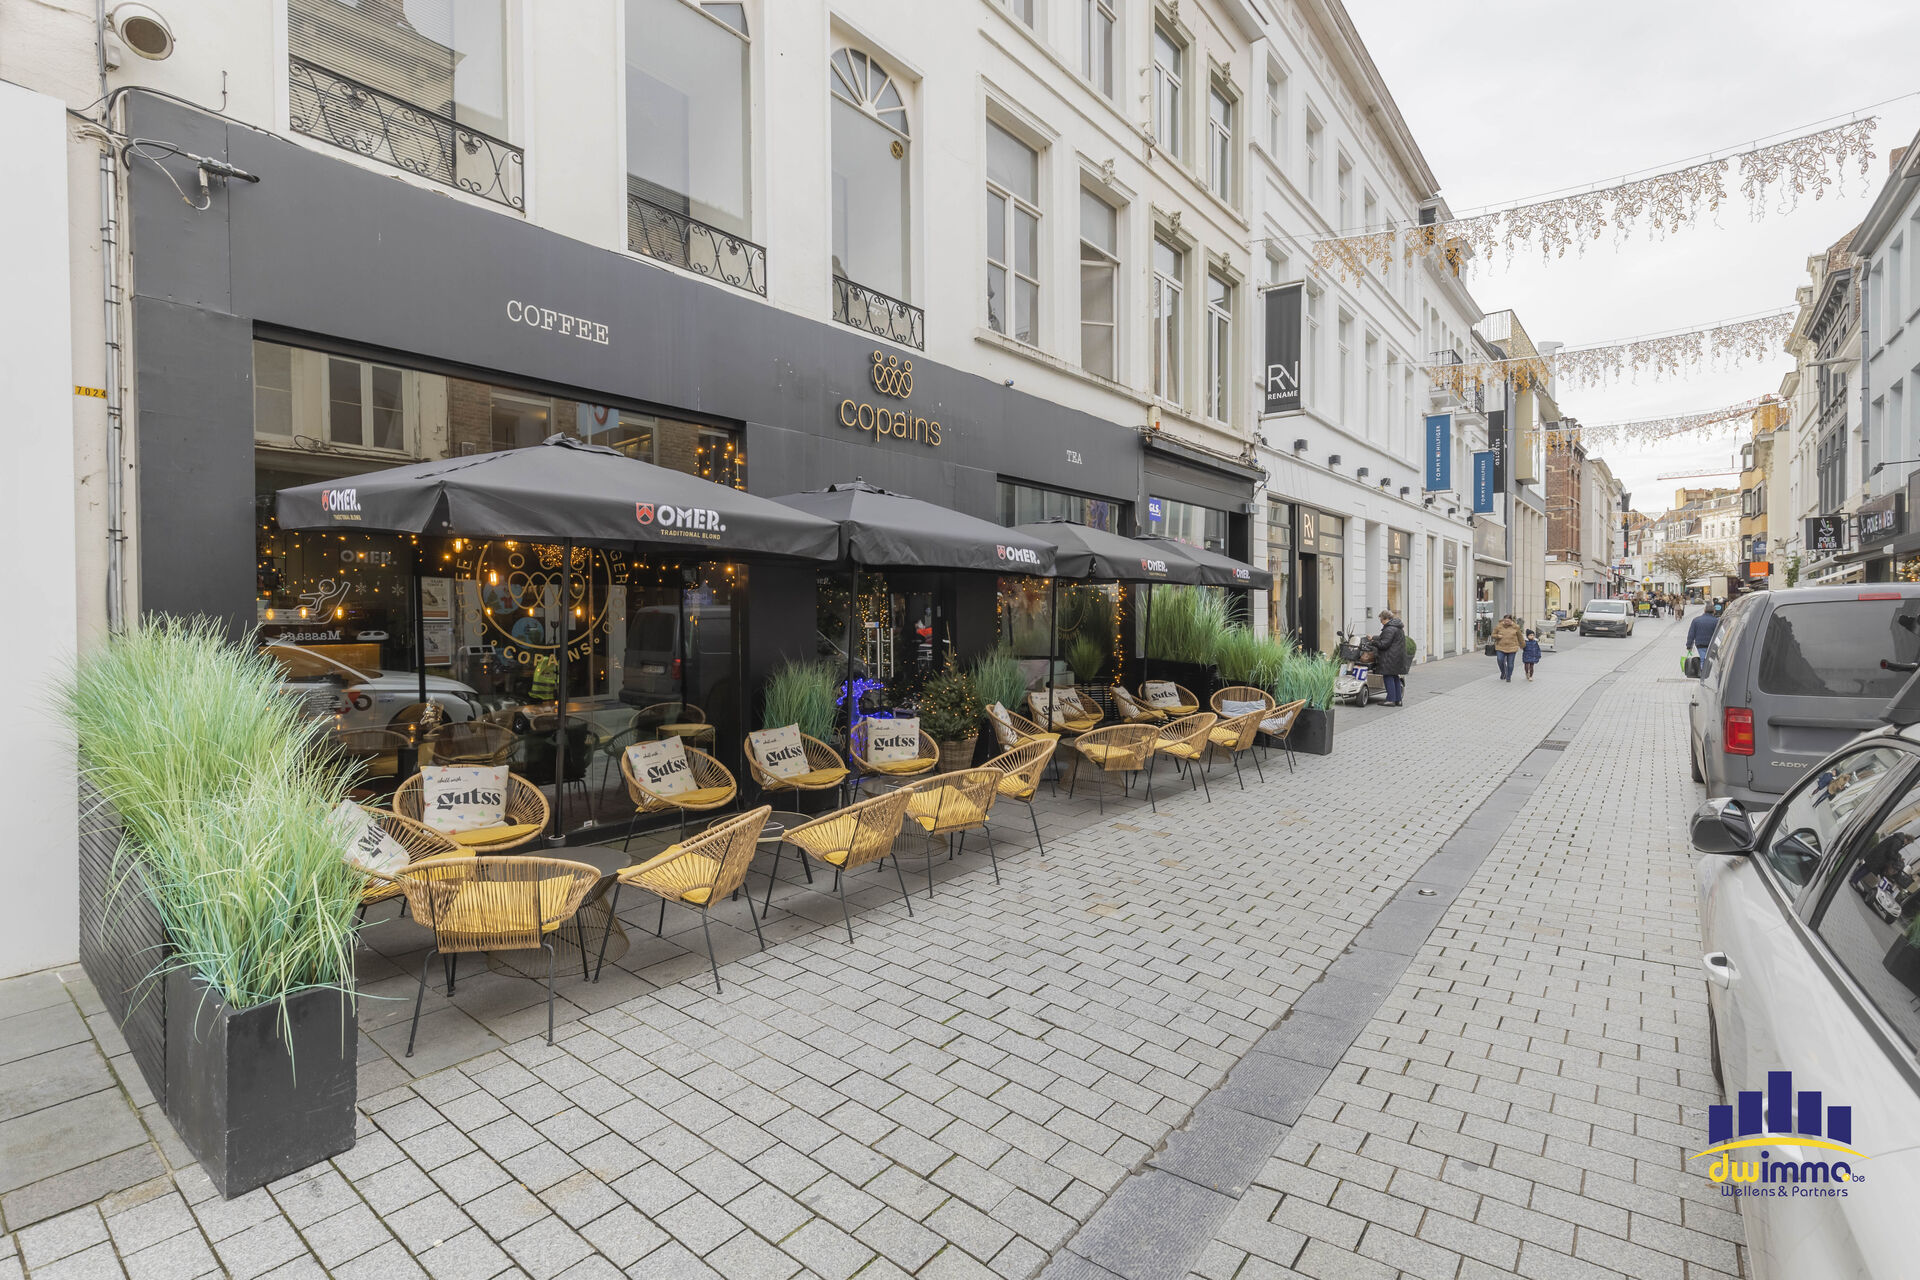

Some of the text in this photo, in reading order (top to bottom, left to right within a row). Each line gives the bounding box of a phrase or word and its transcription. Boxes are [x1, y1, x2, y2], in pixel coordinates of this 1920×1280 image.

[506, 300, 609, 345] COFFEE
[1268, 360, 1299, 392] RN
[76, 386, 106, 398] 7024
[1267, 390, 1299, 400] RENAME
[840, 399, 942, 446] copains
[1066, 450, 1083, 465] TEA
[328, 488, 362, 512] OMER.
[656, 505, 727, 532] OMER.
[1303, 513, 1314, 539] RN
[660, 528, 700, 539] TRADITIONAL
[1006, 546, 1041, 565] OMER.
[503, 642, 592, 666] COPANS
[874, 735, 916, 751] gutss
[766, 746, 803, 767] gutss
[1771, 761, 1808, 769] CADDY
[647, 758, 688, 783] gutss
[436, 788, 502, 811] gutss
